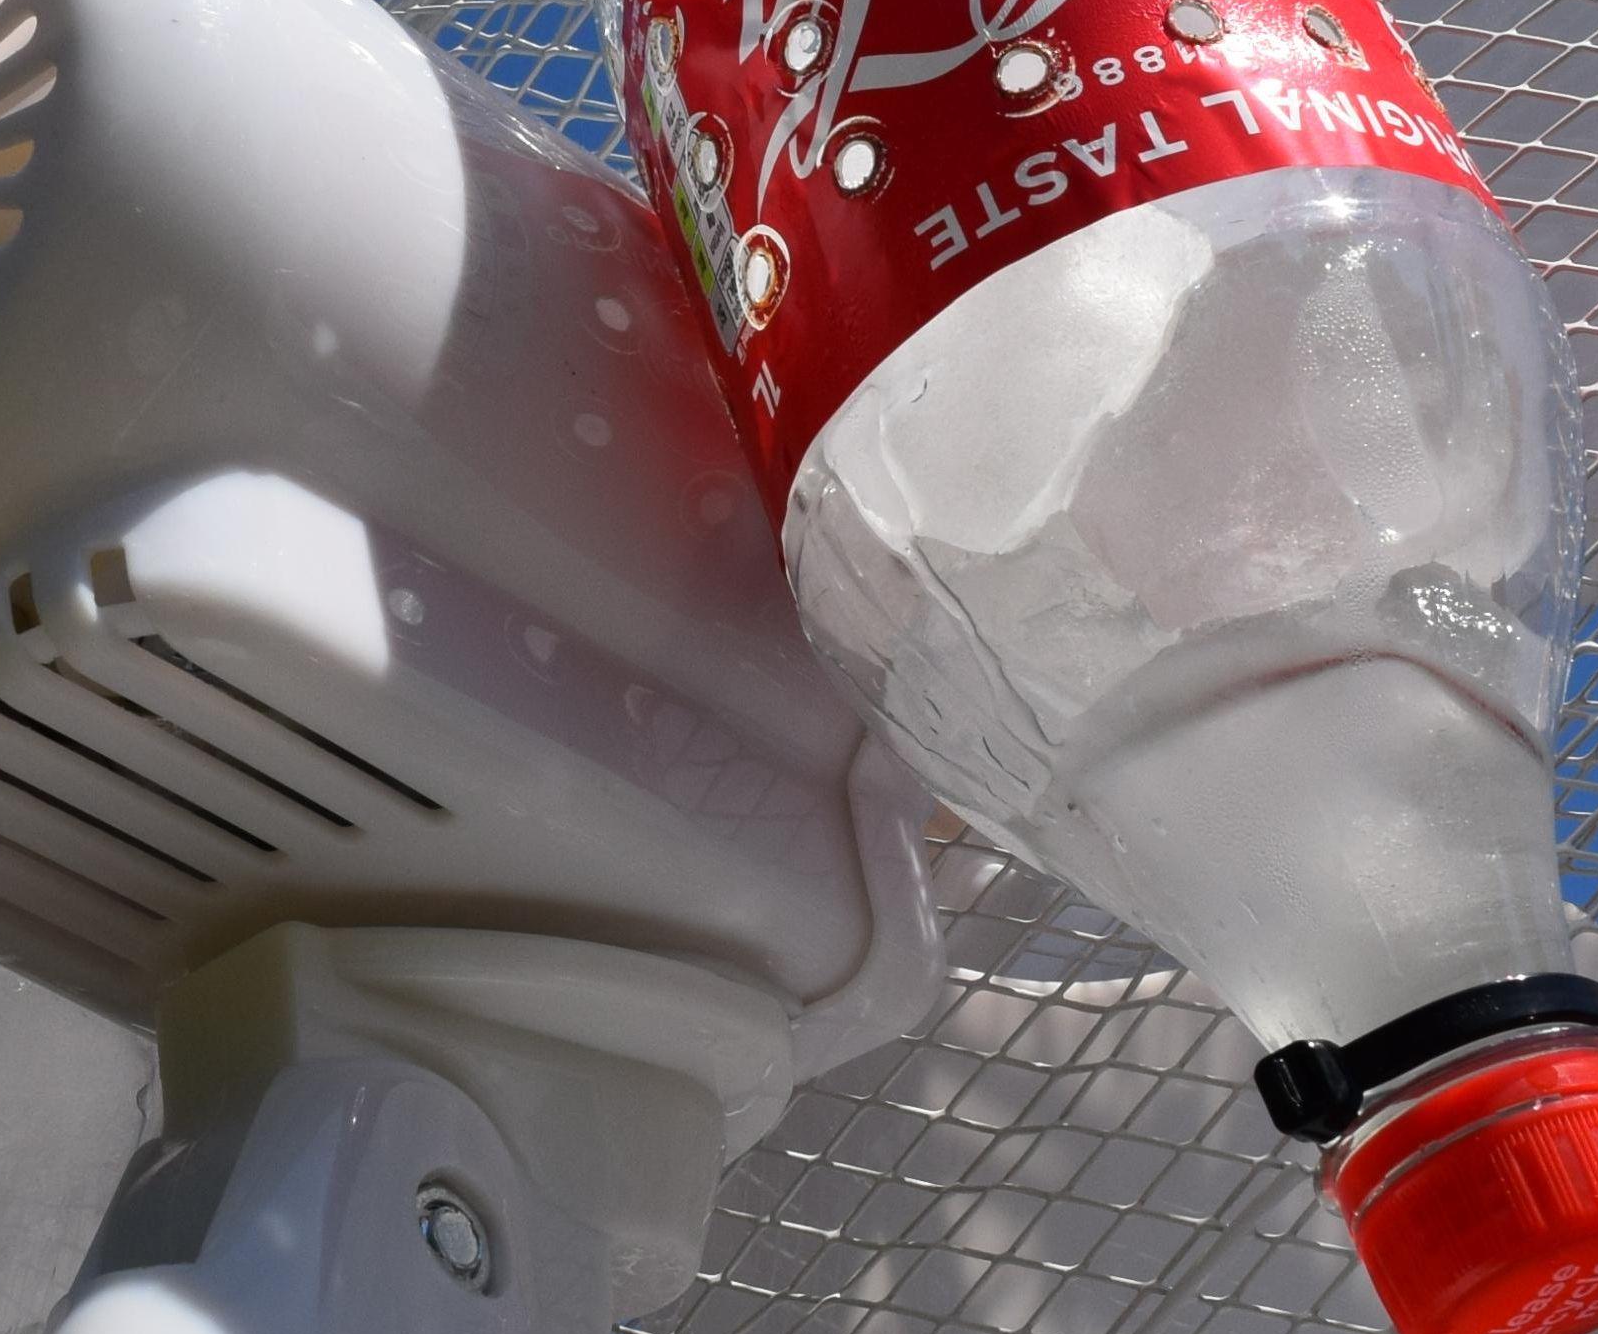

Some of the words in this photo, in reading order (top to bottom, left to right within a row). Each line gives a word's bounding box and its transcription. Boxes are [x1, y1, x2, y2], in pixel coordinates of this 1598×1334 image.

[914, 110, 1188, 271] TASTE
[1201, 89, 1490, 192] RIGINAL
[752, 360, 781, 418] 1L
